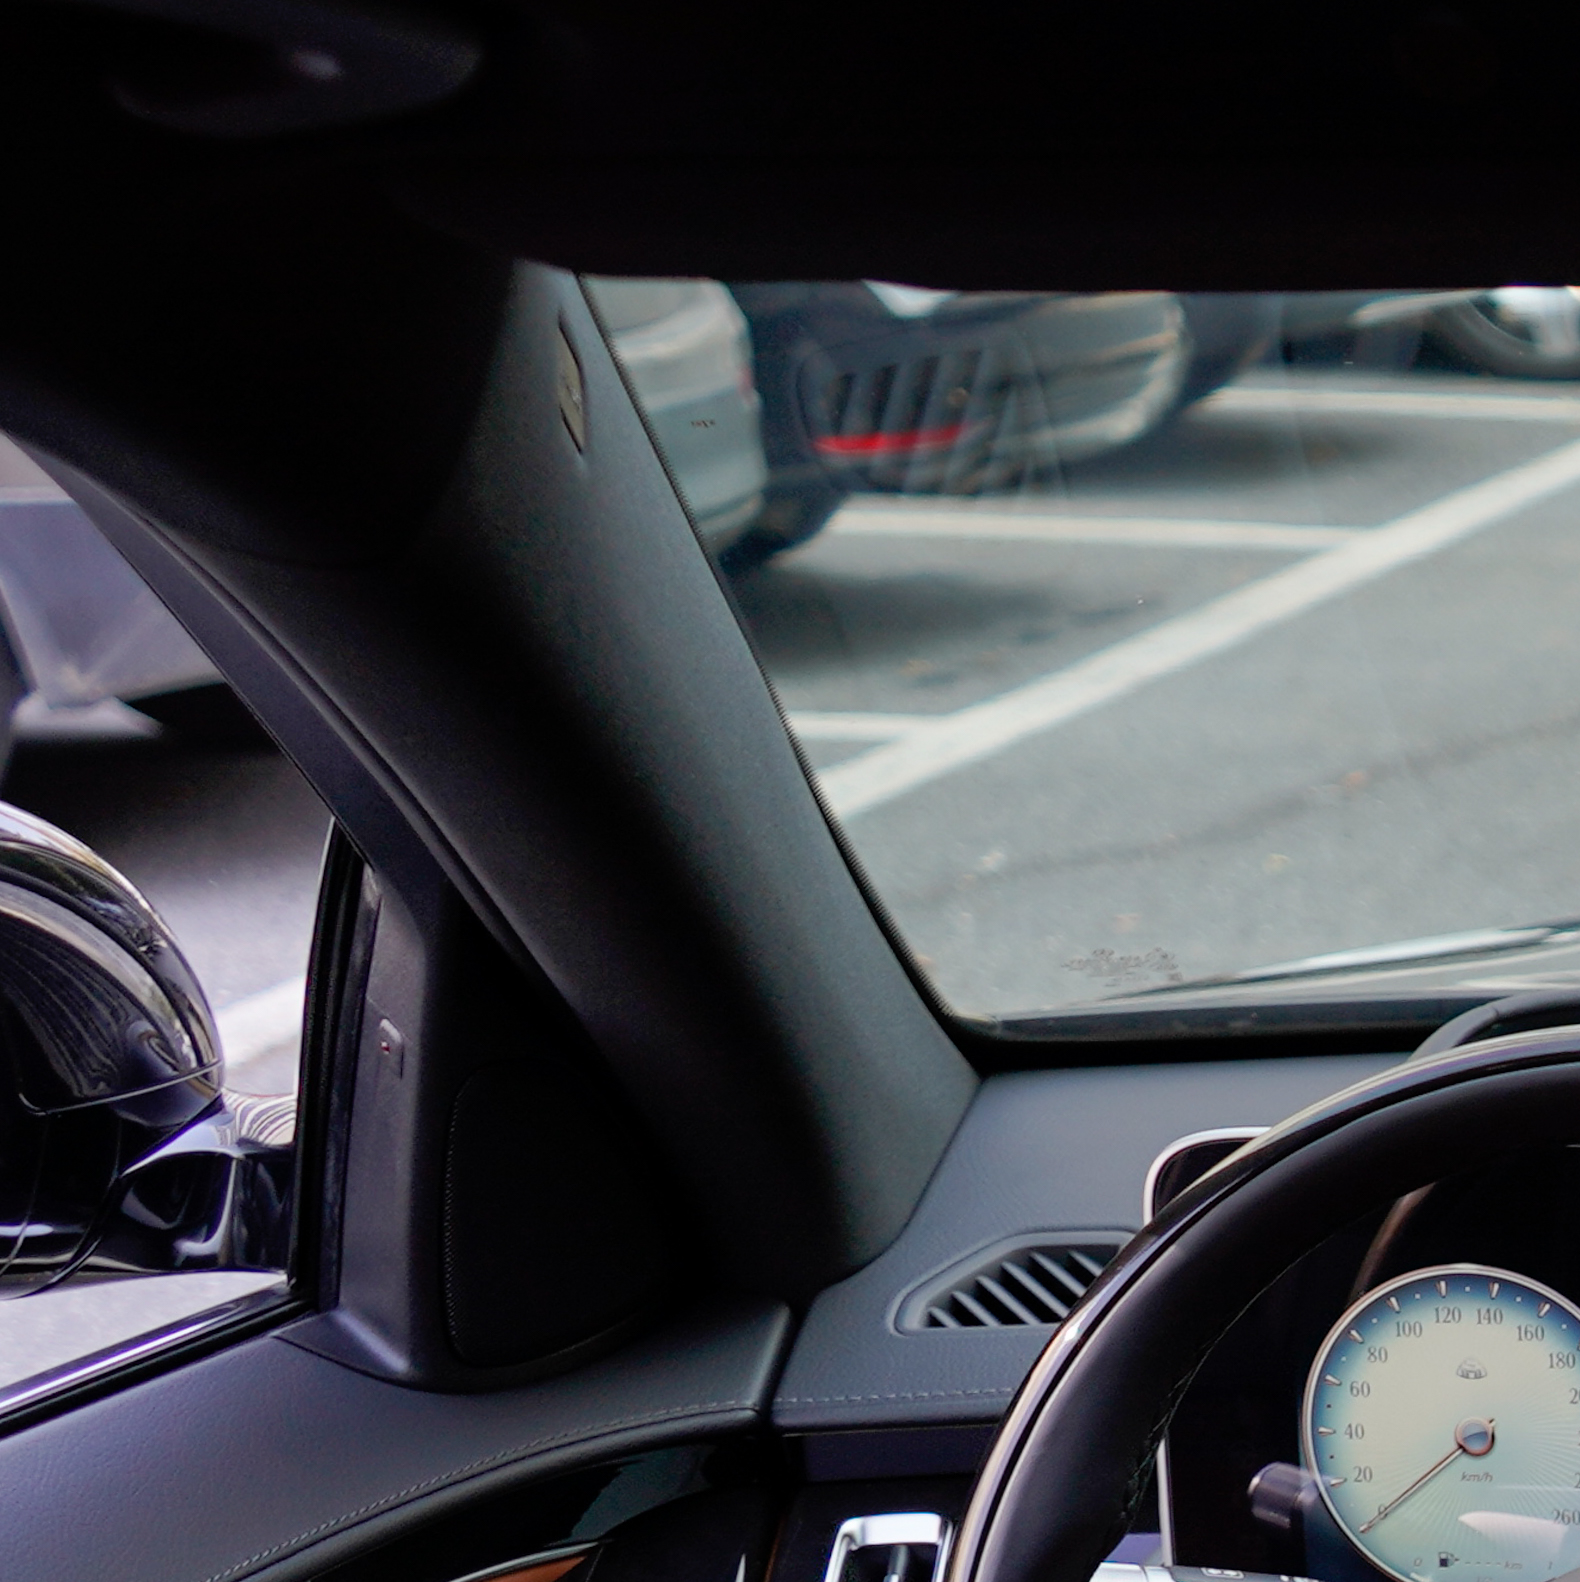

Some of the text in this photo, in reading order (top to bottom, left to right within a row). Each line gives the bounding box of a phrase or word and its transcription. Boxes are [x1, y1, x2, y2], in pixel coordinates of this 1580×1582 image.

[1434, 1307, 1462, 1324] 120
[1476, 1308, 1504, 1325] 140
[1395, 1321, 1423, 1338] 100
[1516, 1325, 1545, 1342] 160
[1367, 1347, 1388, 1363] 80
[1549, 1352, 1576, 1369] 180
[1349, 1381, 1371, 1398] 60
[1344, 1423, 1365, 1440] 40
[1353, 1466, 1373, 1483] 20
[1459, 1471, 1494, 1484] km/h
